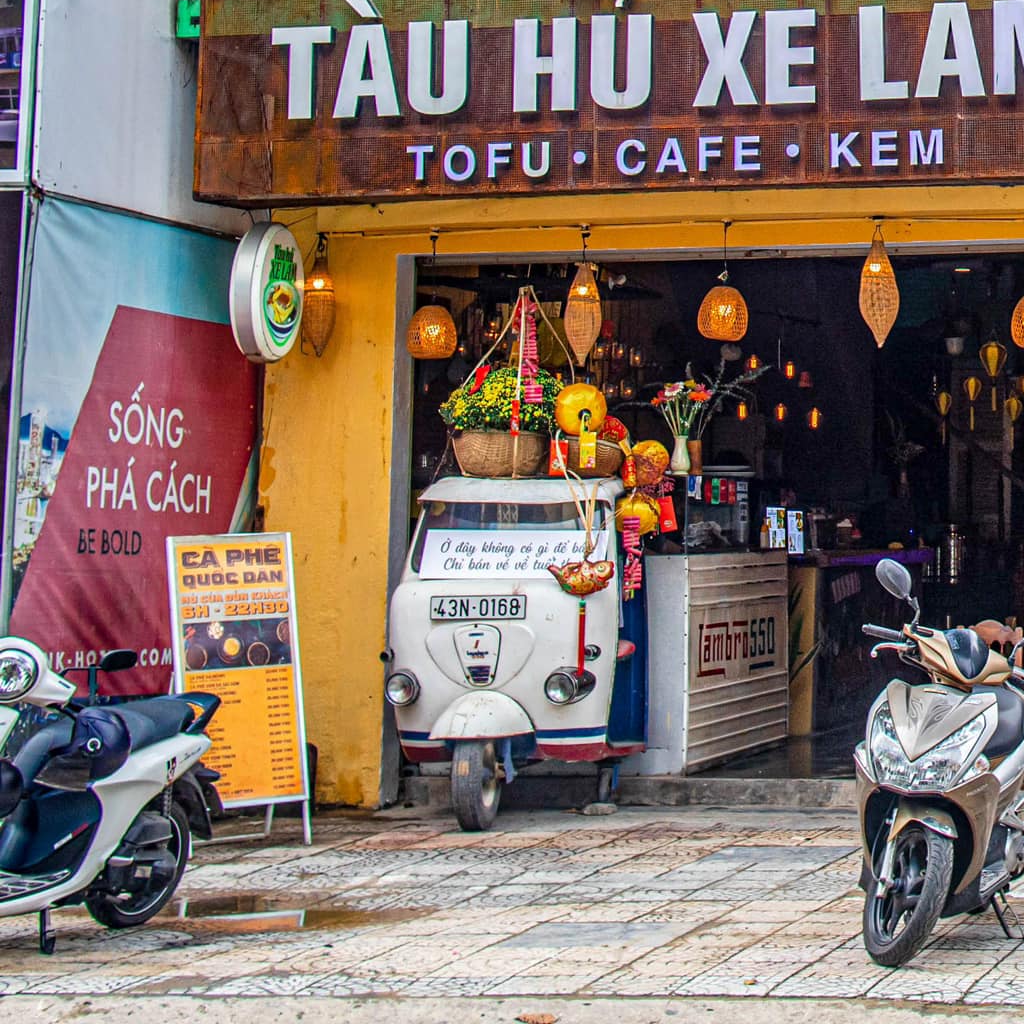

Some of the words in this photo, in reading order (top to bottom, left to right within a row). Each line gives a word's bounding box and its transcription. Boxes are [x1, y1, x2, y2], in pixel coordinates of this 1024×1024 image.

[692, 8, 818, 107] XE
[406, 141, 551, 182] TOFU
[615, 134, 762, 176] CAFE
[829, 128, 944, 169] KEM
[108, 381, 184, 449] SỐNG
[86, 456, 138, 511] PHÁ
[146, 460, 212, 514] CÁCH
[77, 528, 96, 554] BE
[101, 528, 142, 555] BOLD
[520, 542, 533, 553] có
[571, 542, 587, 553] bá
[182, 605, 209, 619] 6H
[224, 600, 289, 617] 22H30
